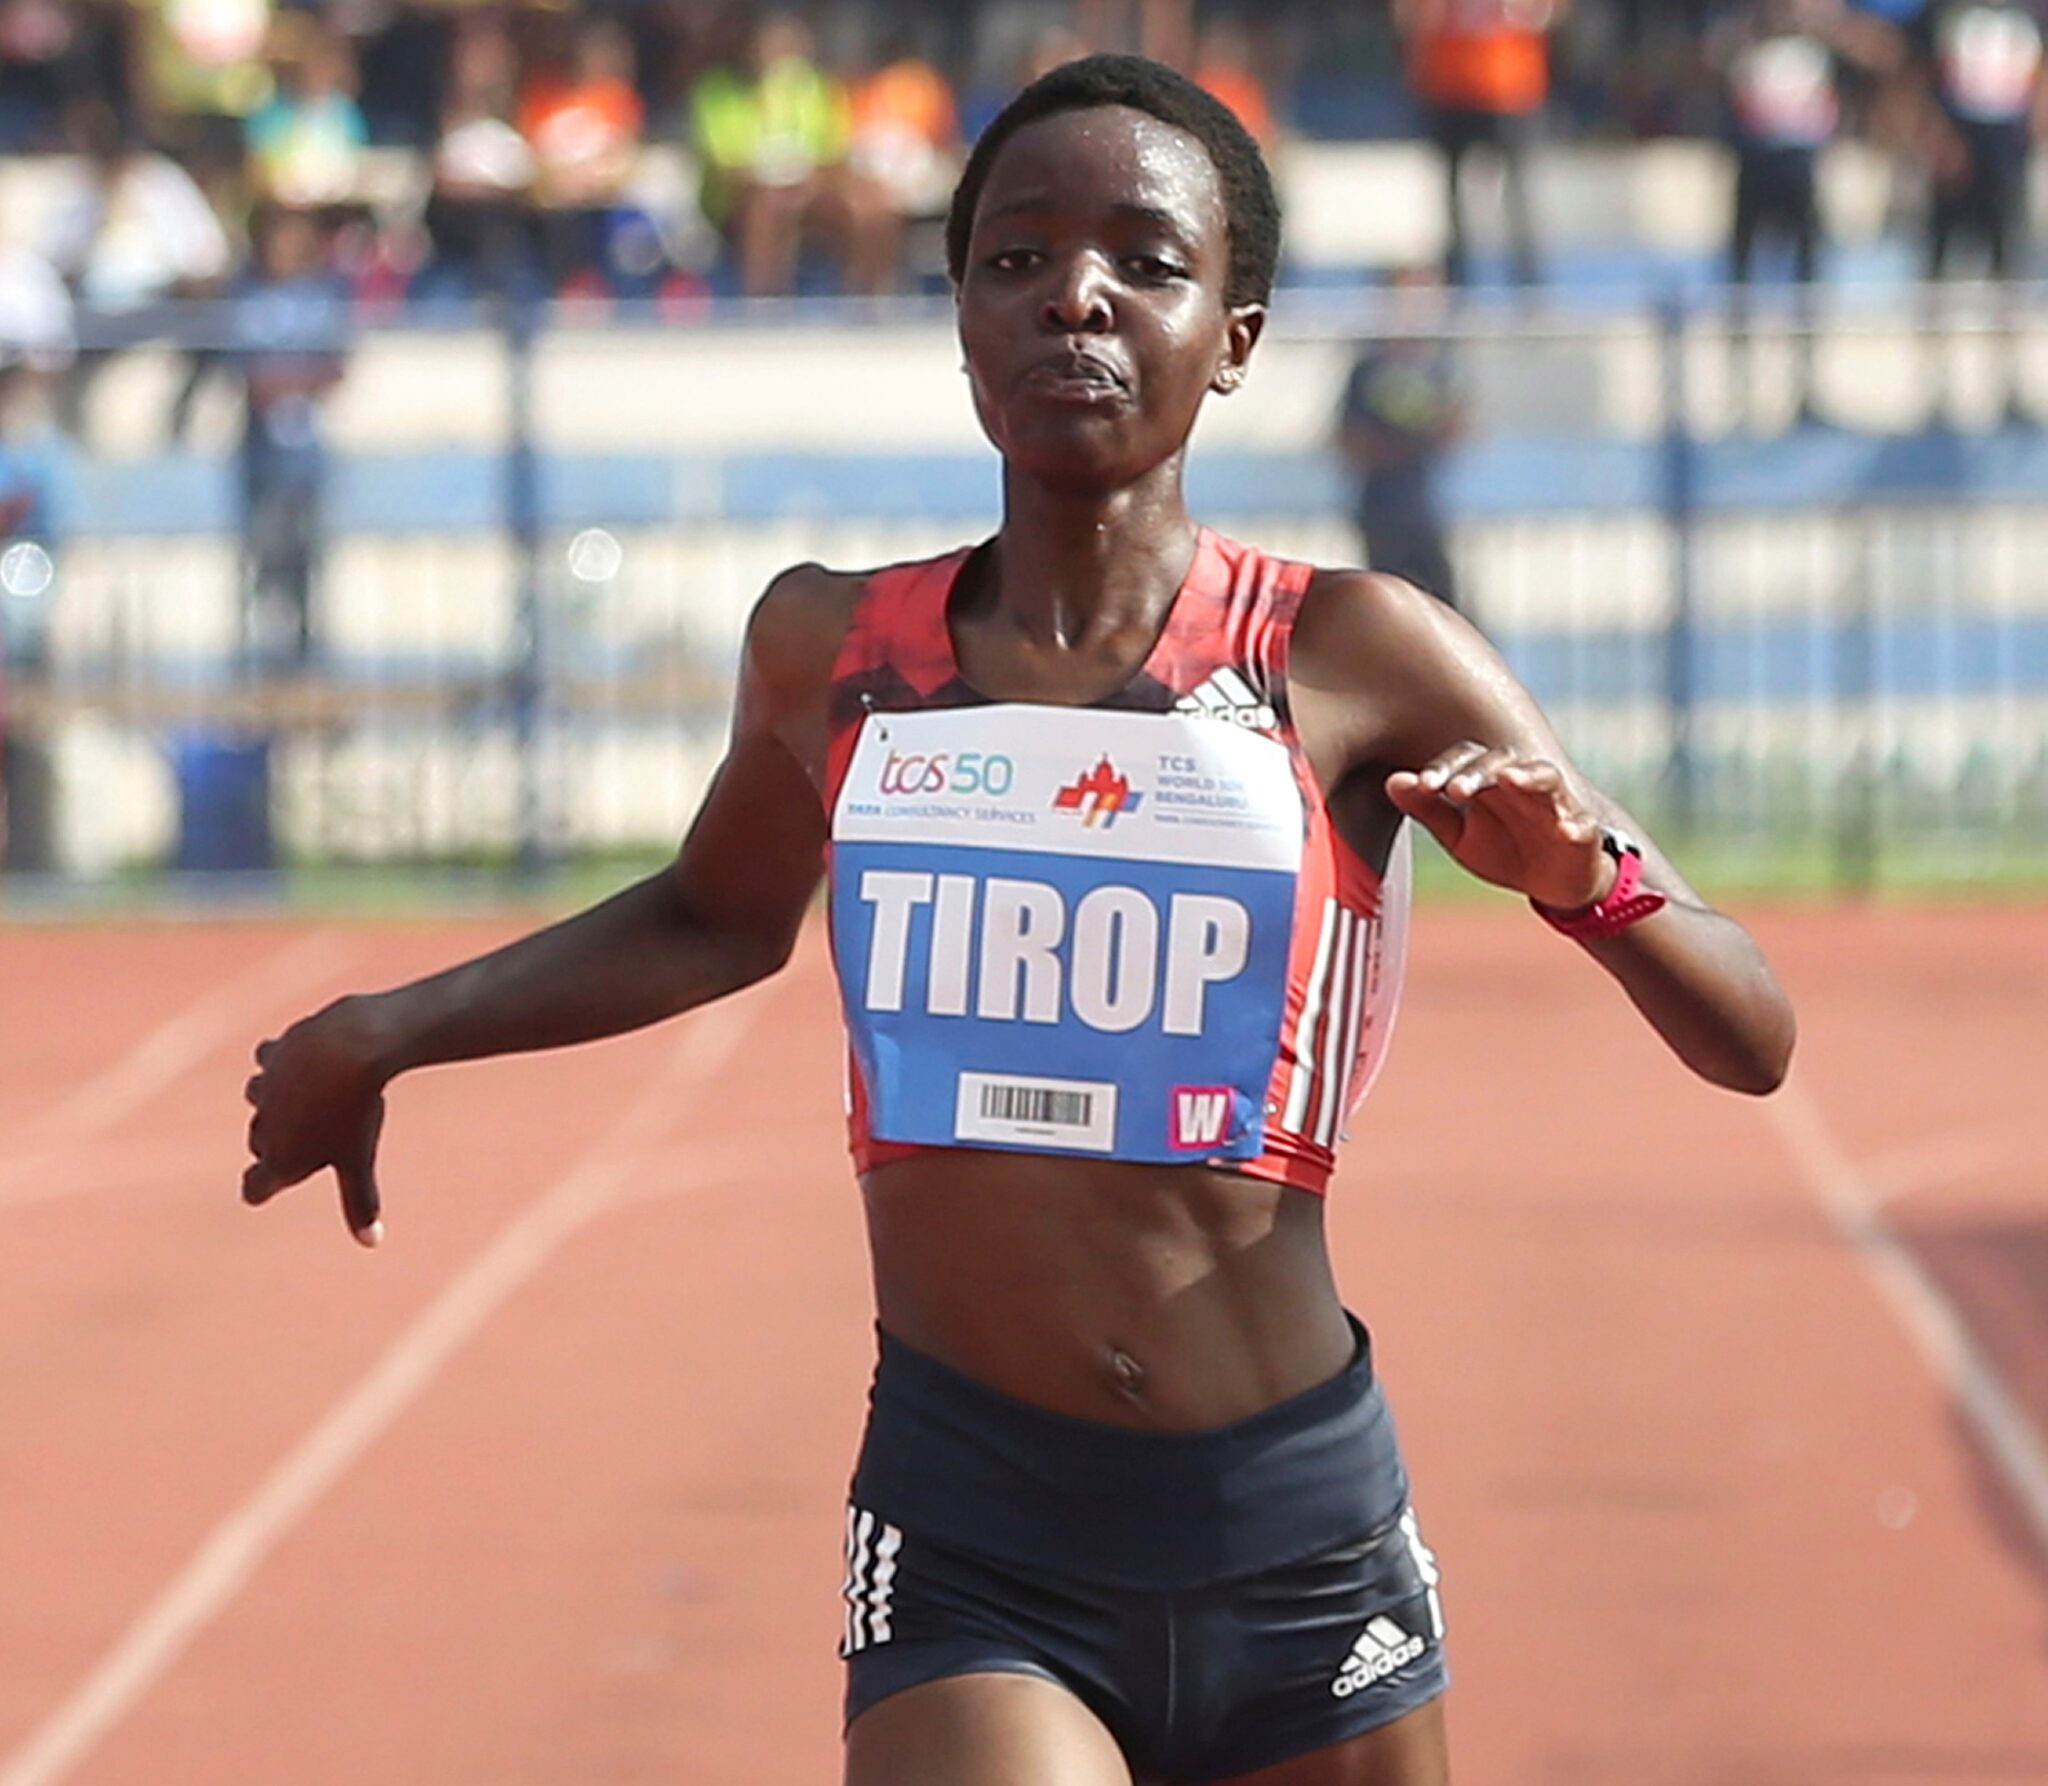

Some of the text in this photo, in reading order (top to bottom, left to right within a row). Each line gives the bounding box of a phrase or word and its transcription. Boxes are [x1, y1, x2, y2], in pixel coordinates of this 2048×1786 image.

[1157, 776, 1216, 790] WORLD
[1159, 755, 1196, 772] TCS
[860, 871, 1250, 1036] TIROP
[1177, 1093, 1228, 1143] W
[1331, 1634, 1425, 1697] adidas
